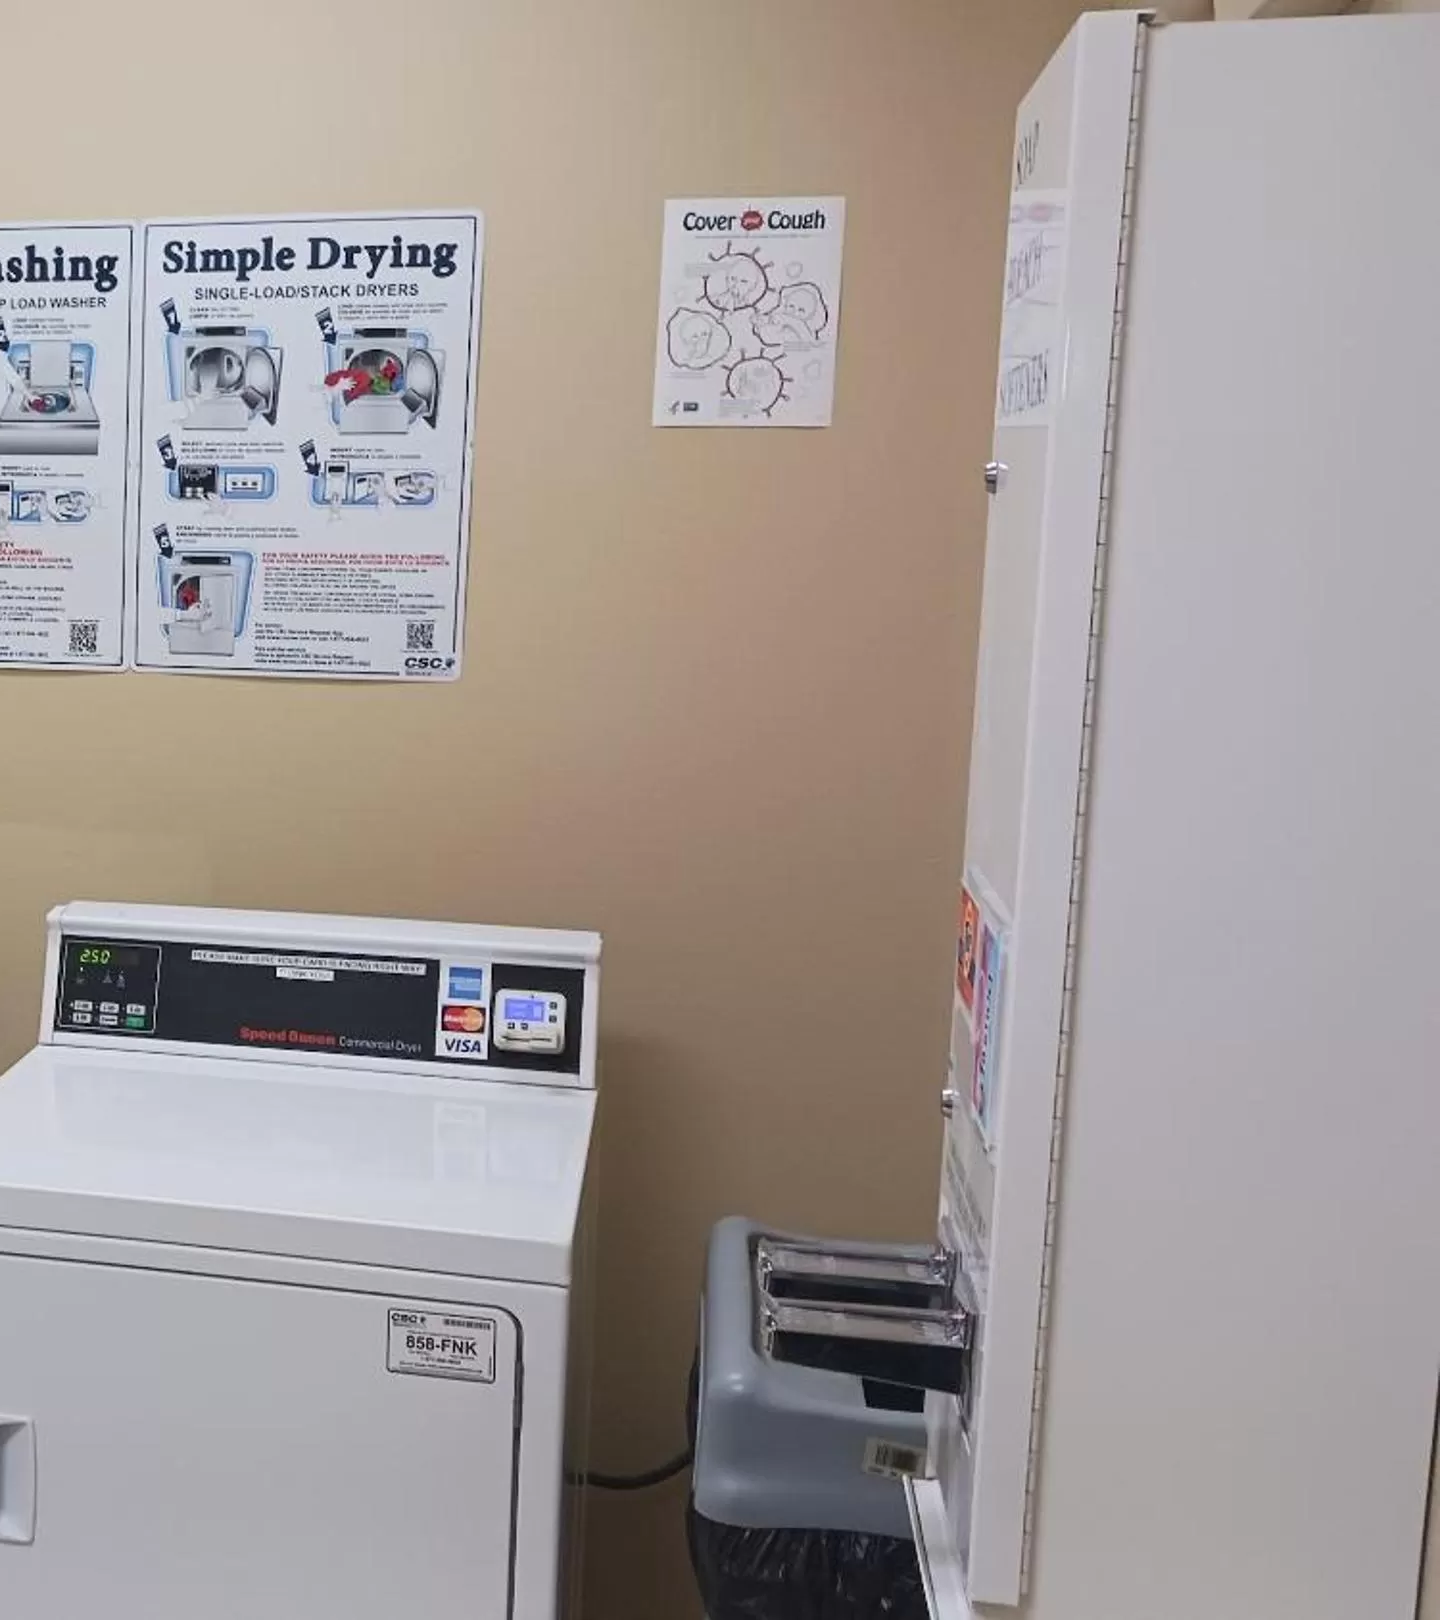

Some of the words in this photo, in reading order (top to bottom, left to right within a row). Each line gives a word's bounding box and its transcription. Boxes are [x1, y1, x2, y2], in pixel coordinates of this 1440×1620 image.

[683, 212, 737, 231] Cover
[767, 209, 826, 230] Cough
[162, 236, 296, 282] Simple
[307, 235, 459, 279] Drying
[194, 285, 351, 301] SINGLE-LOAD/STACK
[355, 283, 420, 298] DRYERS
[10, 297, 47, 310] LOAD
[50, 296, 107, 309] WASHER
[404, 656, 442, 669] CSC
[239, 1027, 287, 1043] Speed
[289, 1030, 336, 1046] Queen
[338, 1036, 394, 1049] Commercial
[444, 1038, 482, 1053] VISA
[406, 1335, 478, 1357] 858-FNK
